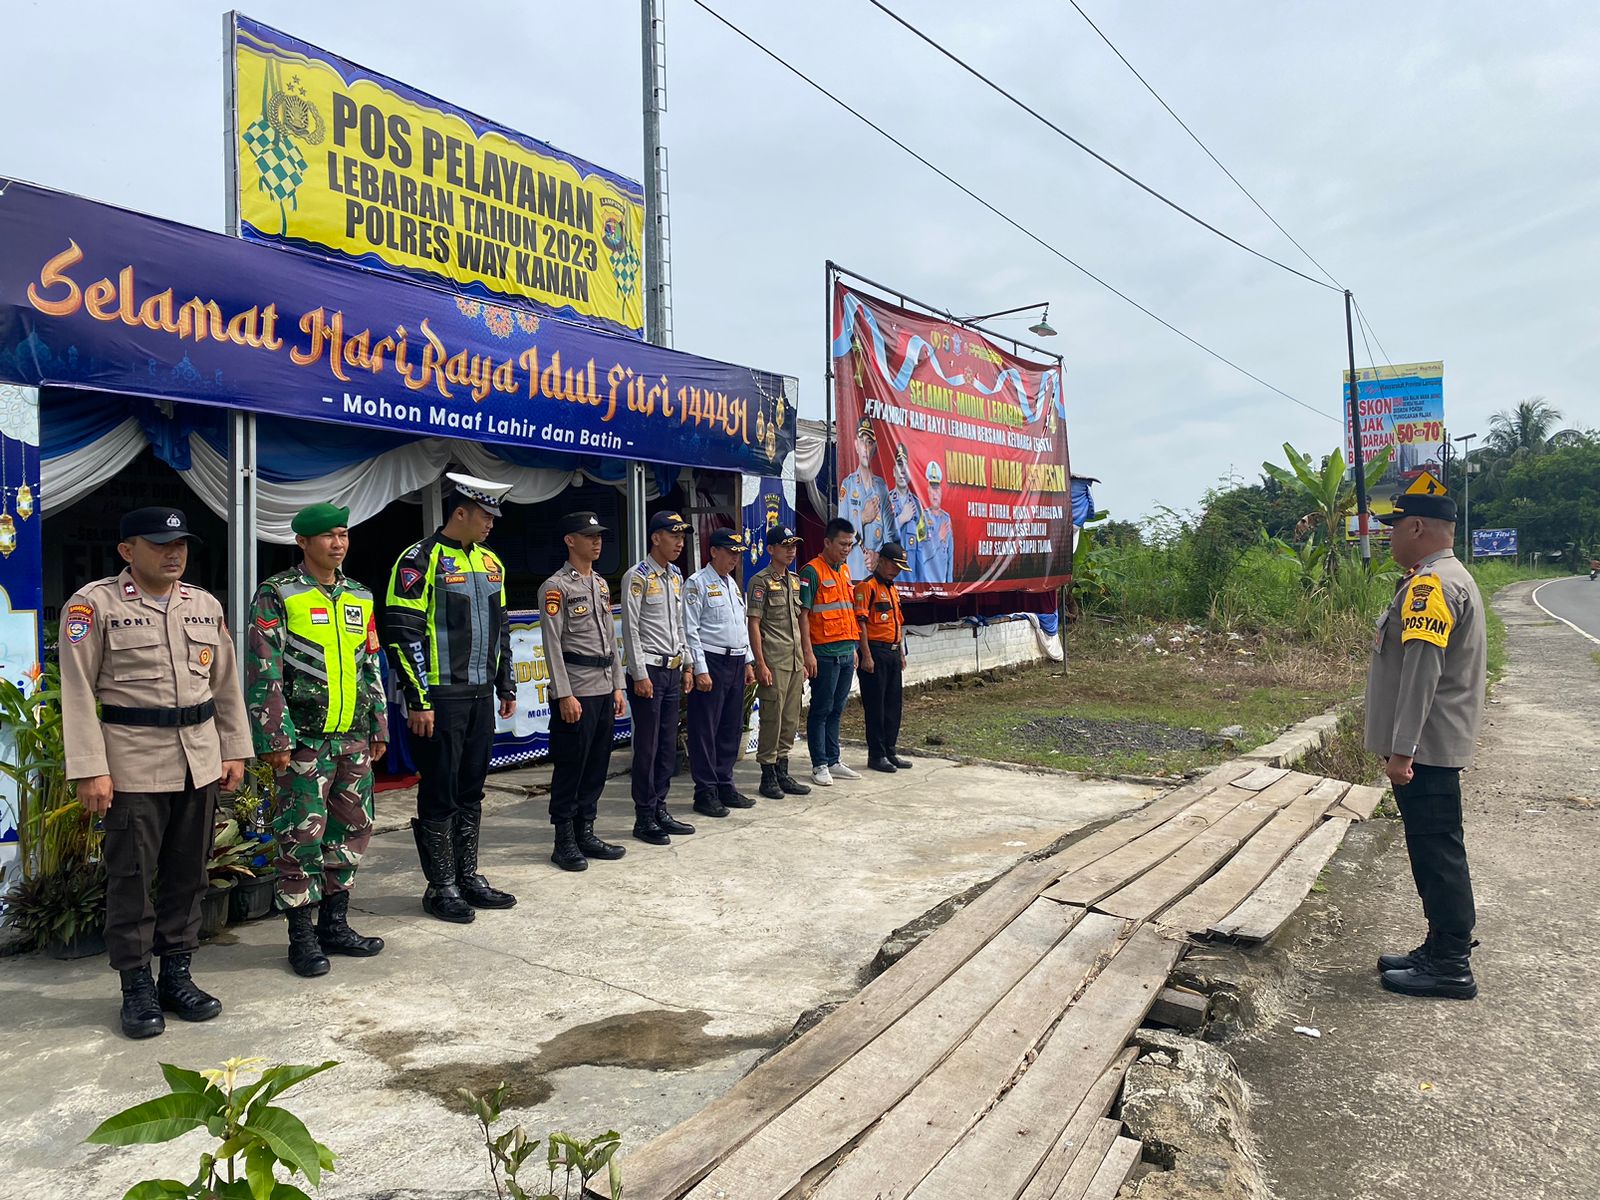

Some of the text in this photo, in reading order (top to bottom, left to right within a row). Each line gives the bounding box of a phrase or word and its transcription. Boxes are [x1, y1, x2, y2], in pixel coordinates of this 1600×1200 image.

[332, 91, 594, 234] POS PELAYANAN
[328, 150, 598, 272] LEBARAN TAHUN 2023
[346, 198, 589, 303] POLRES WAY KANAN
[27, 237, 750, 444] Selamat Hari Raya Idul Fitri 1444H
[343, 392, 421, 423] Mohon
[429, 405, 483, 431] Maaf
[487, 415, 537, 439] Lahir
[541, 422, 574, 444] dan
[580, 429, 622, 449] Batin
[909, 379, 1024, 428] SELAMAT MUDIK LEBARAN
[1347, 398, 1393, 417] DSKON
[1347, 417, 1384, 433] PJAK
[927, 415, 946, 435] RAYA
[948, 419, 977, 440] LEBARAN
[1348, 432, 1395, 448] KDARAAN
[945, 449, 987, 487] MUDIK
[991, 458, 1022, 491] AMAN
[111, 617, 151, 628] RONI
[184, 616, 215, 625] POLRI
[408, 640, 429, 691] POLIS
